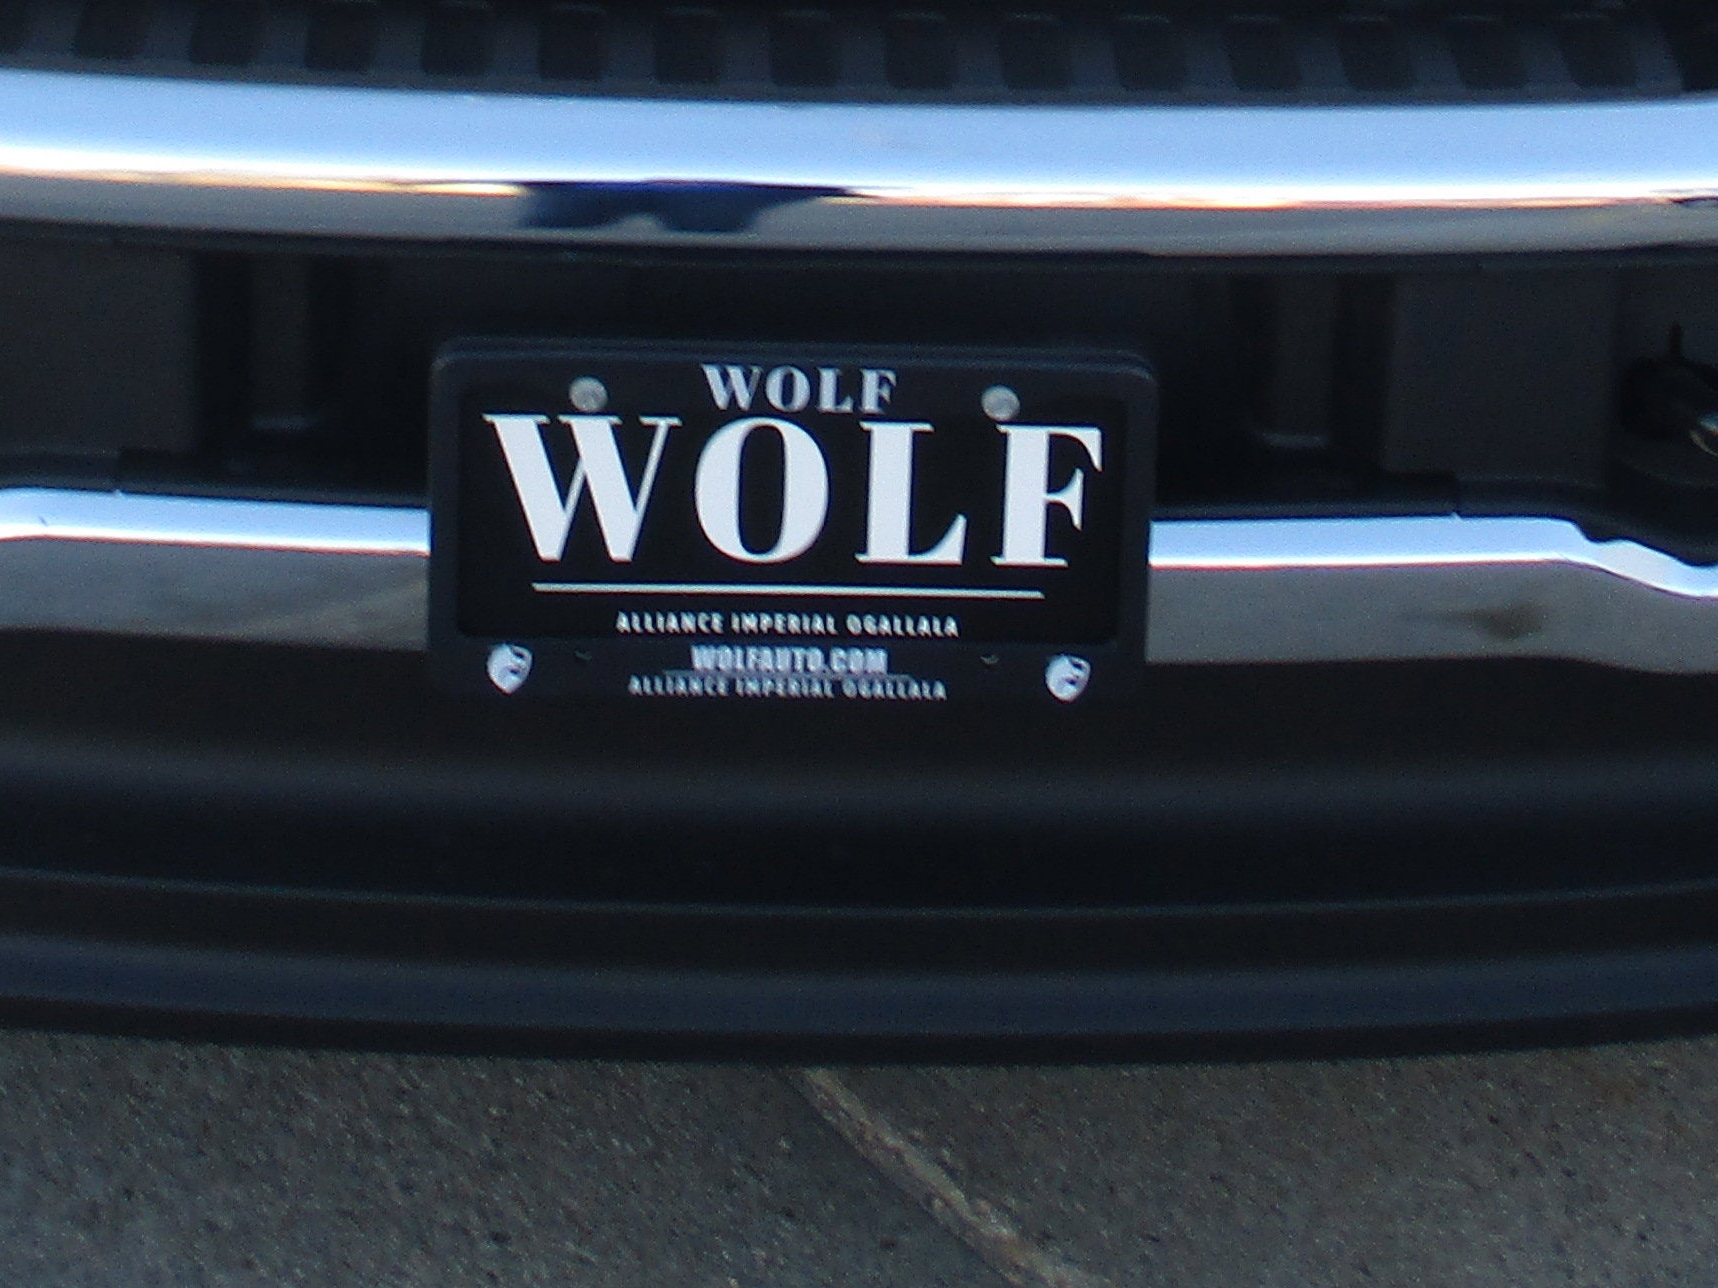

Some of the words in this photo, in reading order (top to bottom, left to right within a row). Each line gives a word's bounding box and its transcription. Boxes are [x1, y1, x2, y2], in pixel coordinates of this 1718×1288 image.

[701, 362, 898, 415] WOLF
[483, 413, 1104, 566] WOLF
[616, 610, 724, 634] ALLIANCE
[731, 612, 838, 635] IMPERIAL
[690, 644, 889, 676] WOLFAUTO.COM
